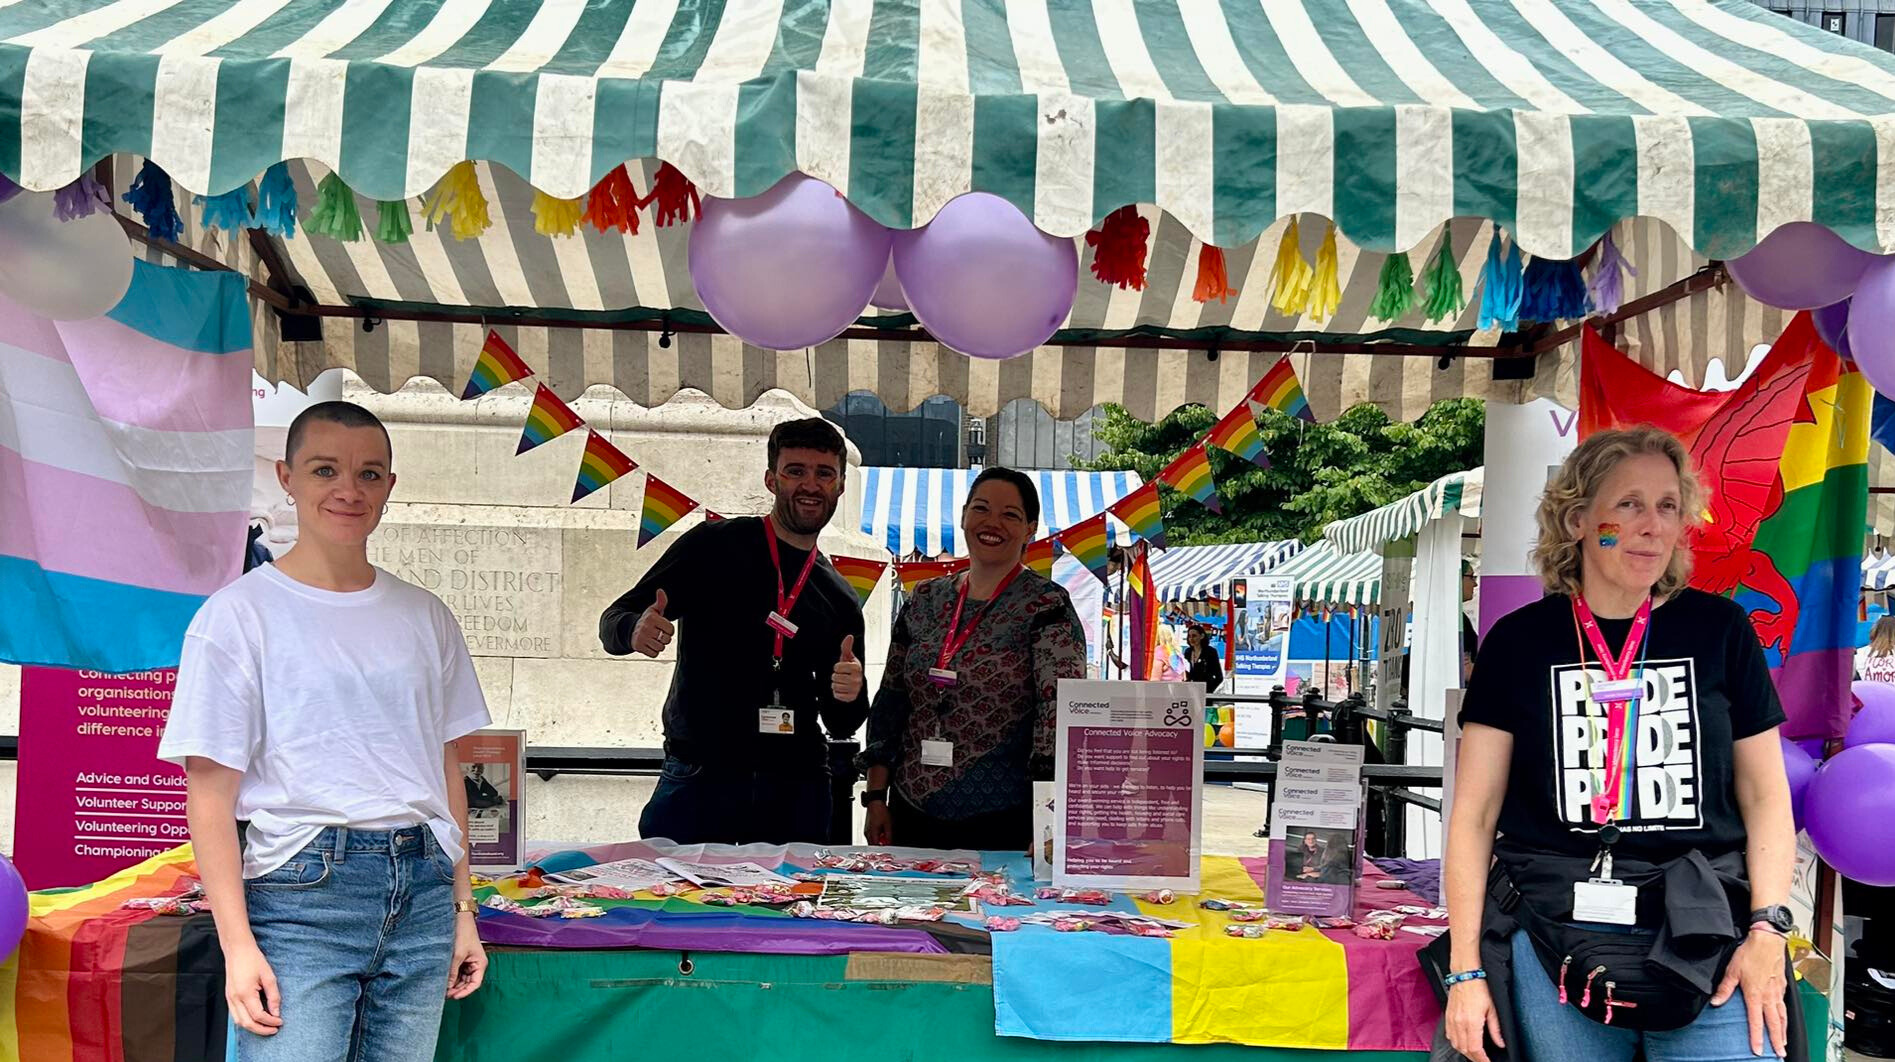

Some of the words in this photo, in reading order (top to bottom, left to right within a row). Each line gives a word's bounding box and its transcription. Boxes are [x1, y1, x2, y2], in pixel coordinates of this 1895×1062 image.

[1549, 409, 1578, 437] V
[417, 528, 528, 547] AFFECTION
[399, 548, 443, 564] MEN
[450, 569, 560, 593] DISTRICT
[463, 594, 515, 612] LIVES
[1069, 700, 1110, 709] Connected
[78, 704, 170, 721] volunteering
[77, 722, 153, 737] difference
[1083, 728, 1121, 737] Connected
[1123, 729, 1143, 737] Voice
[1144, 729, 1178, 738] Advocacy
[1285, 744, 1321, 752] Connected
[1284, 766, 1320, 775] Connected
[76, 772, 122, 783] Advice
[124, 774, 150, 785] and
[1283, 787, 1318, 795] Connected
[76, 796, 139, 809] Volunteer
[1278, 808, 1314, 816] Connected
[75, 820, 157, 836] Volunteering
[160, 823, 190, 837] Opp
